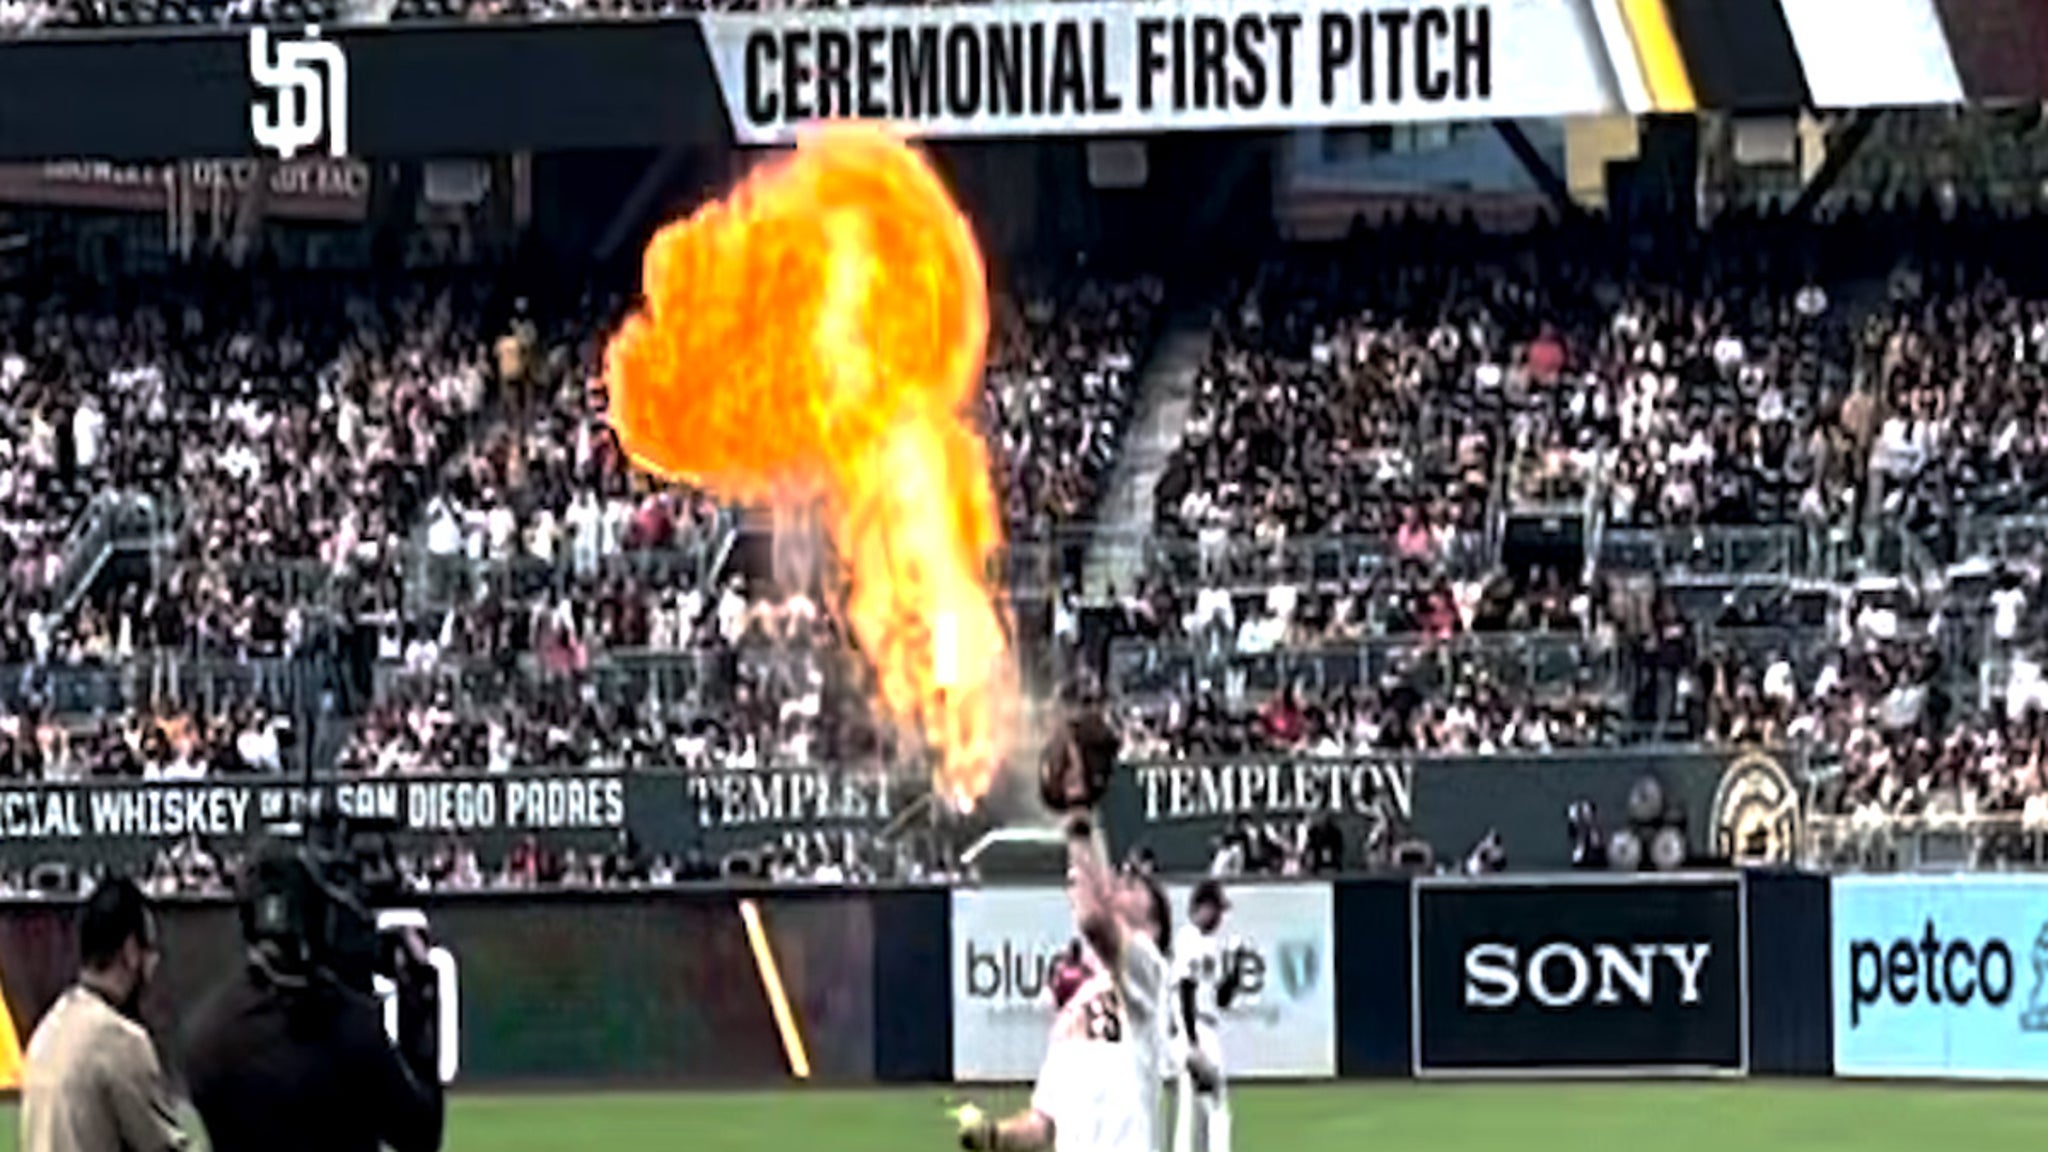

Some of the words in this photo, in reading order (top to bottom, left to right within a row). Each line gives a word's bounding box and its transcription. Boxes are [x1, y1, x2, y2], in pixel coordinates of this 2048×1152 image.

[744, 20, 1122, 125] CEREMONIAL
[1137, 13, 1302, 110] FIRST
[1320, 6, 1493, 105] PITCH
[0, 791, 82, 836] CIAL
[90, 786, 250, 836] WHISKEY
[337, 782, 398, 820] SAN
[408, 783, 496, 830] DIEGO
[506, 778, 625, 829] PADRES
[1464, 943, 1711, 1007] SONY
[1849, 915, 2014, 1031] petco
